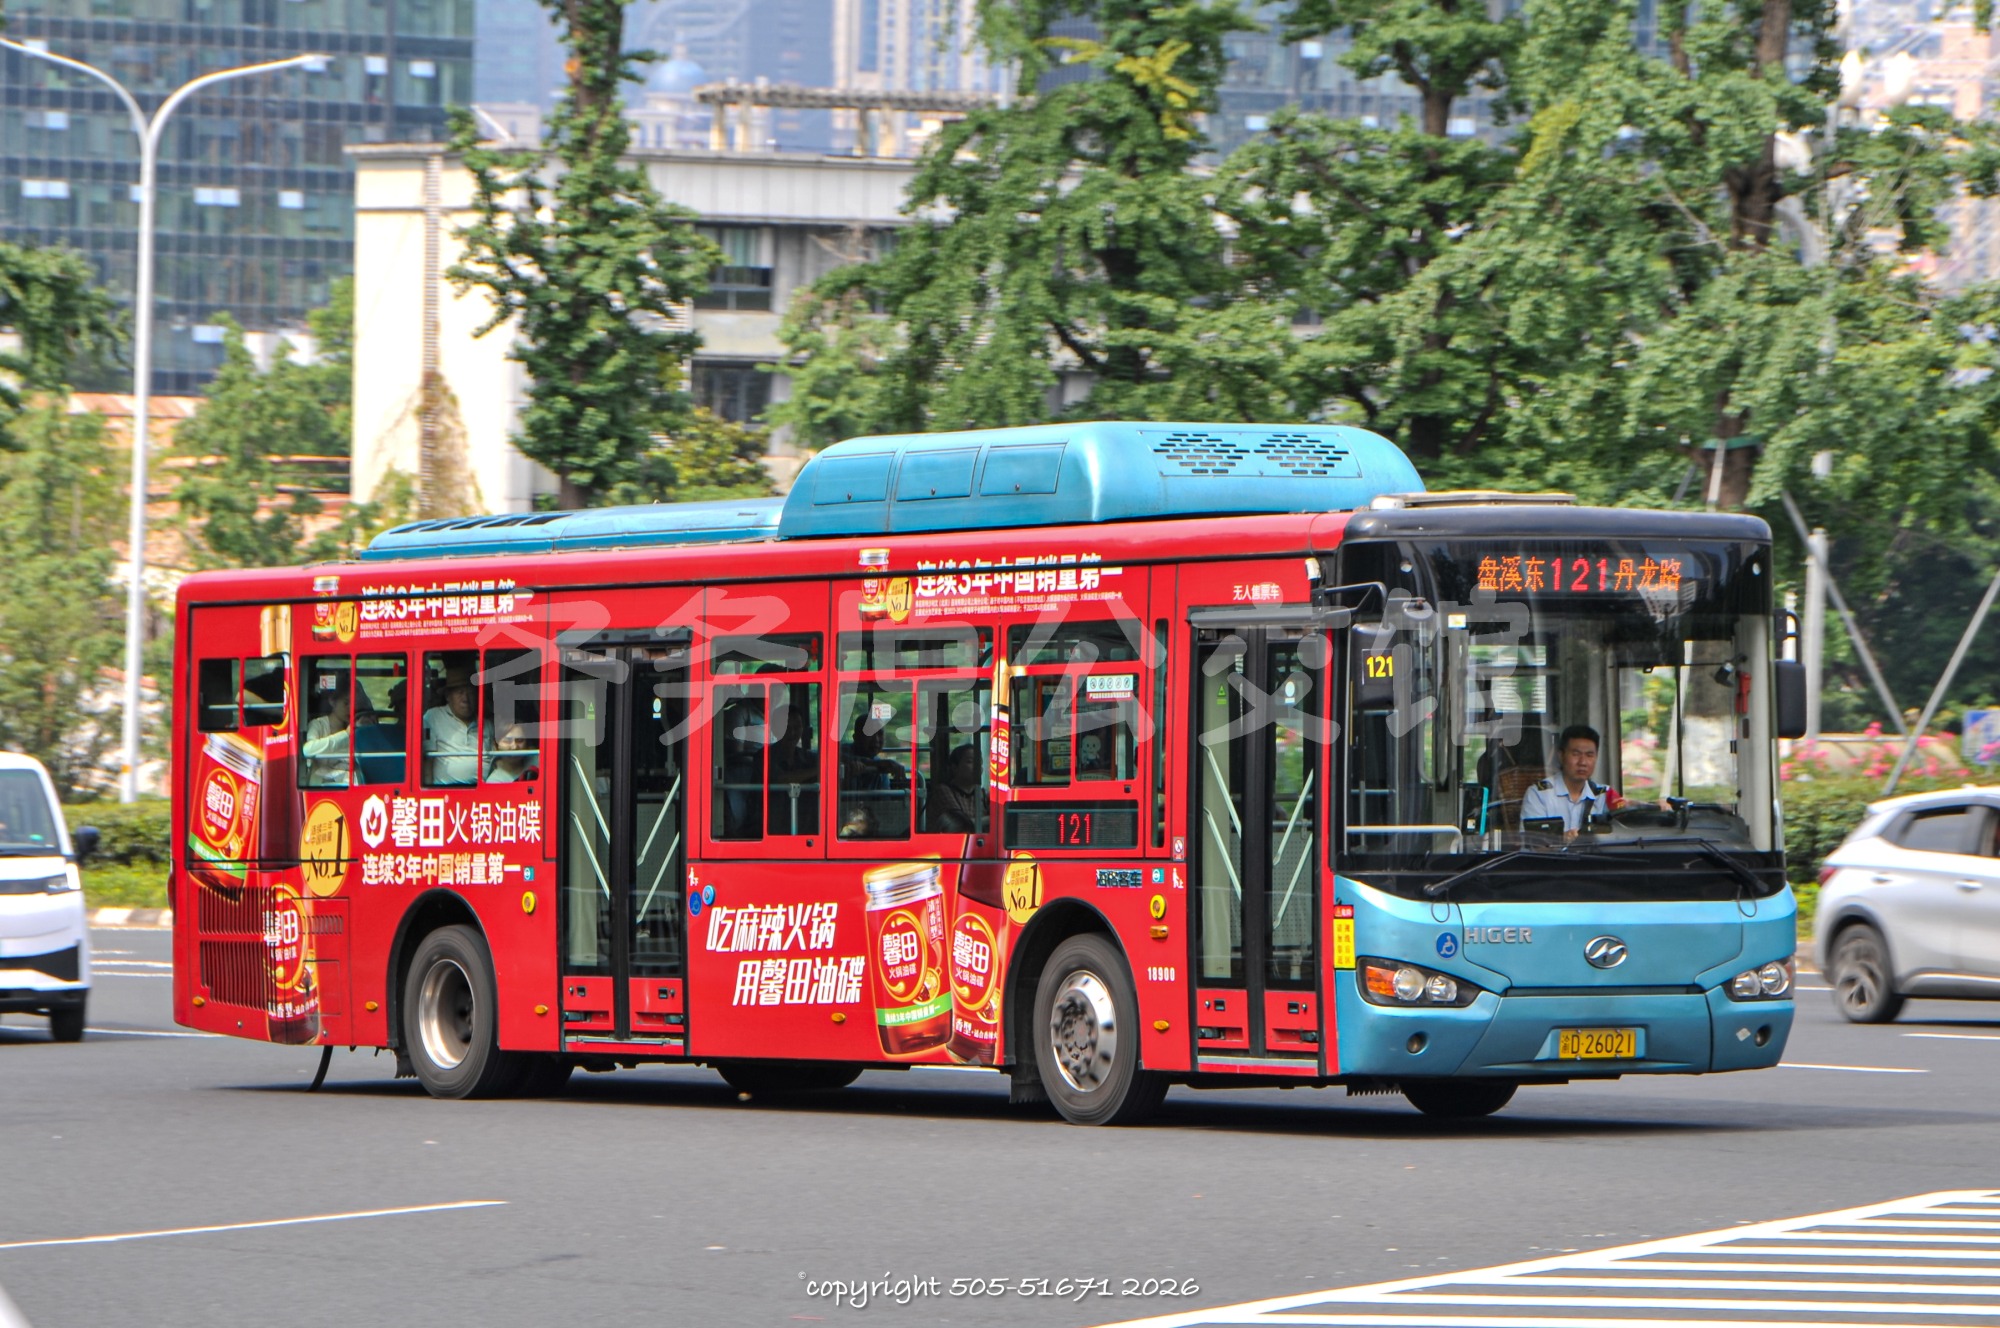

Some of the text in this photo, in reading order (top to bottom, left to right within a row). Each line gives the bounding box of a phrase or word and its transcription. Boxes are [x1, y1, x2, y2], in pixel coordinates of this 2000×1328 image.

[1477, 555, 1682, 592] 盘溪东 121 丹龙路
[1233, 583, 1280, 601] 无人售票车
[1366, 655, 1394, 678] 121
[1058, 813, 1091, 844] 121
[362, 852, 521, 886] 连续3年中国销量第一
[705, 902, 838, 953] 吃麻辣火锅
[1463, 926, 1533, 944] HIGER
[882, 931, 918, 966] 馨田
[953, 929, 990, 974] 馨田
[732, 956, 866, 1007] 用馨田油碟
[1147, 966, 1176, 982] 18900
